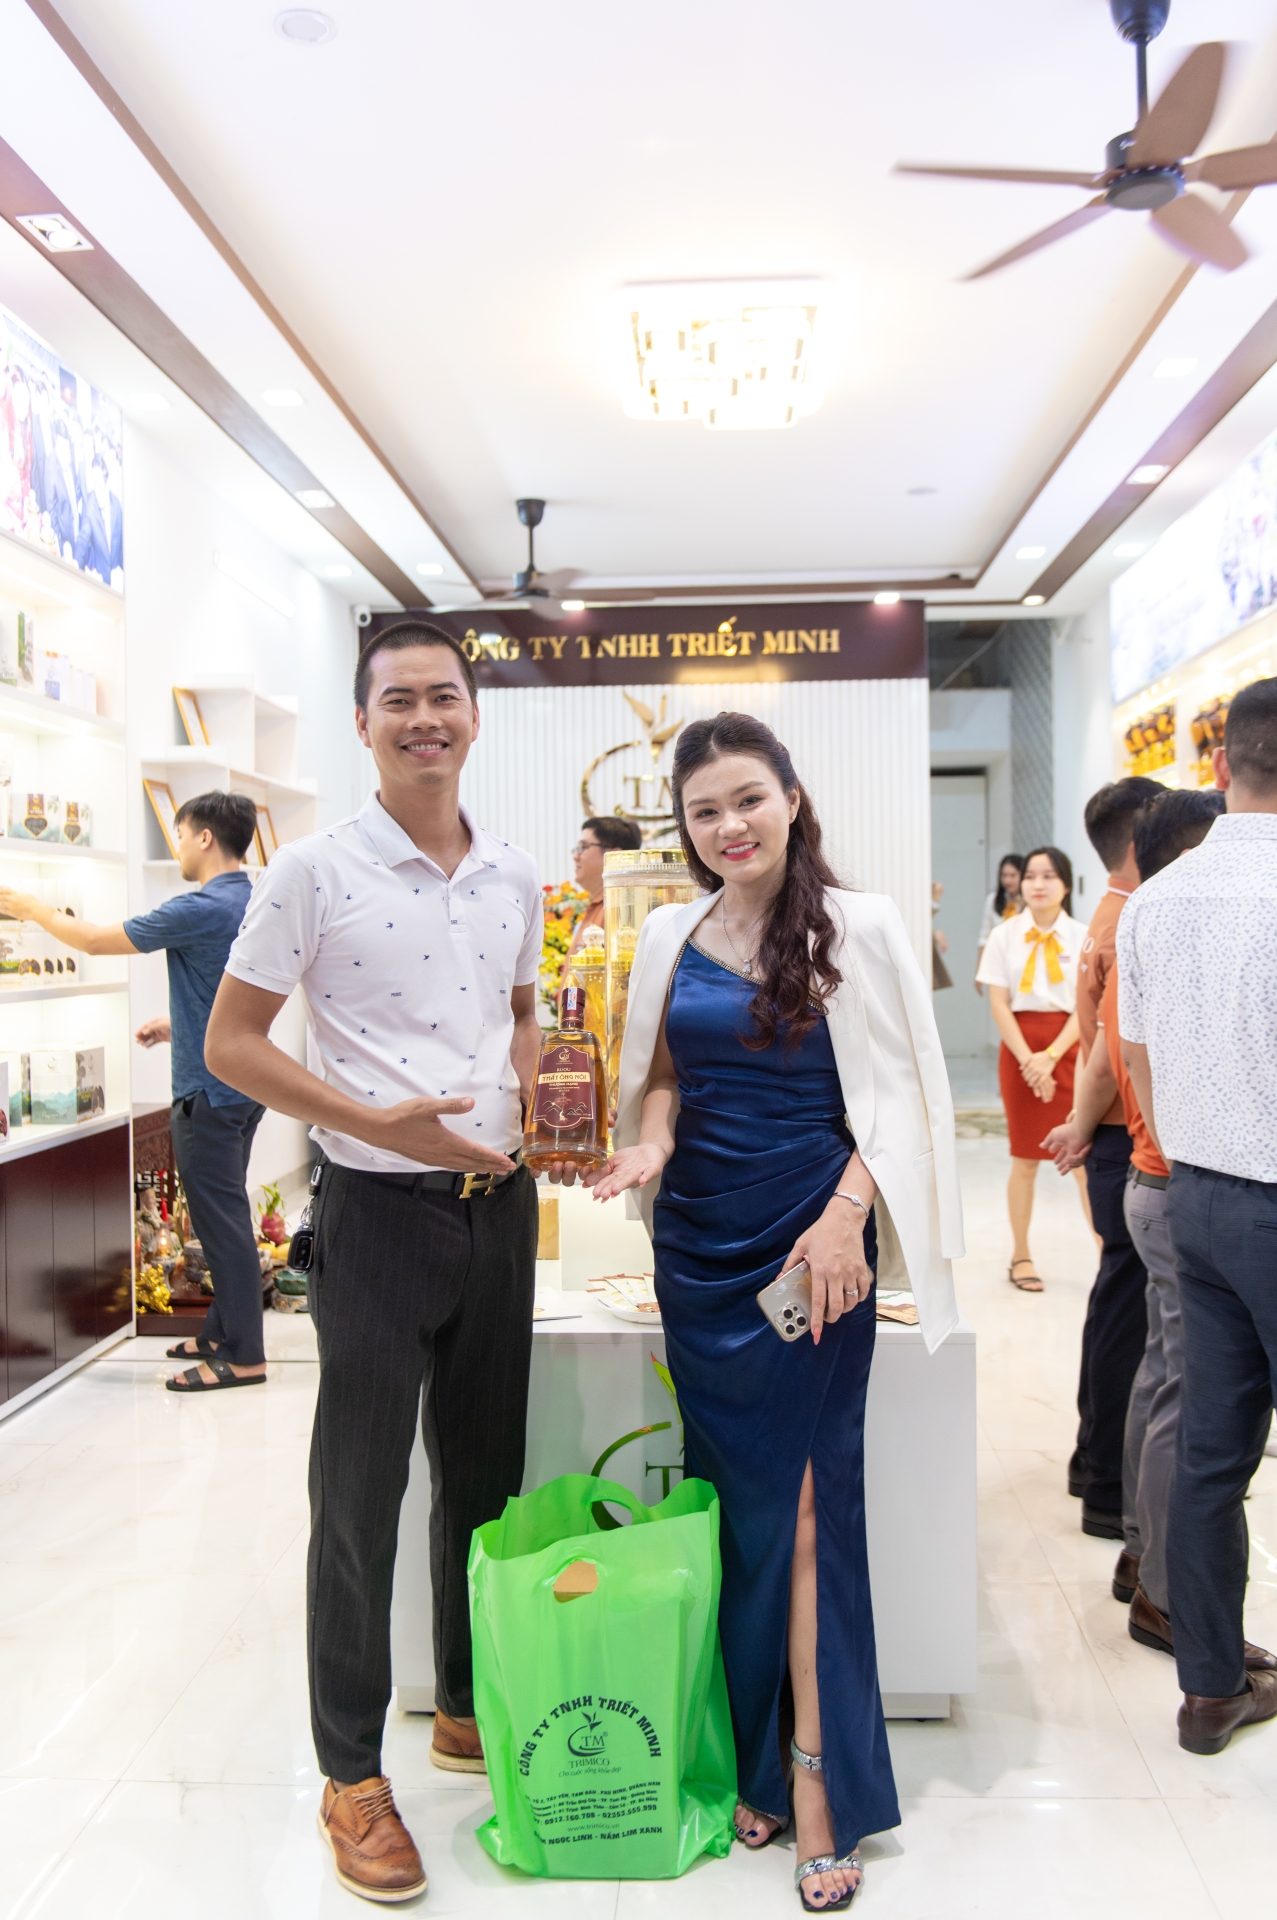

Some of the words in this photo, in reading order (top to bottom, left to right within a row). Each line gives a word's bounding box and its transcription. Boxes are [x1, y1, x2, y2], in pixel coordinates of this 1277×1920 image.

[460, 628, 520, 662] ÔNG
[528, 636, 568, 660] TY
[575, 633, 660, 659] TNHH
[666, 616, 756, 657] TRIẾT
[762, 628, 841, 656] MINH
[517, 1741, 537, 1777] CÔNG
[532, 1719, 550, 1738] TY
[550, 1695, 592, 1719] TNHH
[598, 1696, 639, 1719] TRIẾT
[636, 1716, 662, 1758] MINH
[568, 1757, 610, 1768] TRIMICO
[572, 1833, 593, 1842] LINH
[622, 1828, 637, 1837] LIM
